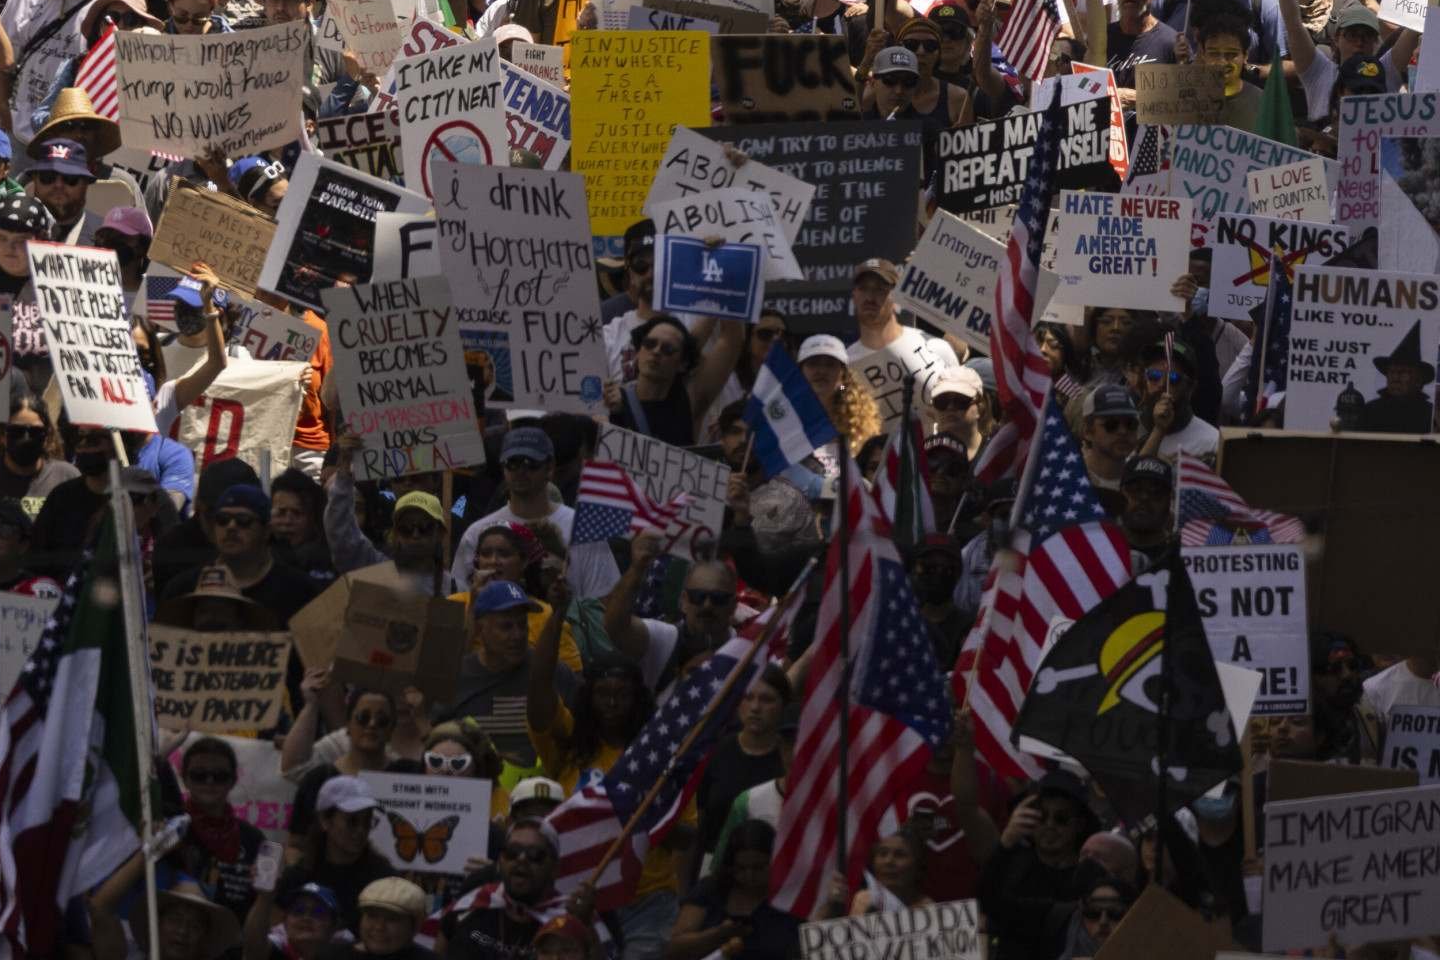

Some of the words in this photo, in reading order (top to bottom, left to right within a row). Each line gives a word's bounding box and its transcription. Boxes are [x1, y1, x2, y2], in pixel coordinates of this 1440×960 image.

[1065, 194, 1114, 216] HATE
[1121, 199, 1181, 220] NEVER
[1097, 218, 1144, 238] MADE
[1075, 235, 1157, 258] AMERICA
[355, 284, 422, 314] WHEN
[1298, 274, 1438, 310] HUMANS
[338, 305, 452, 347] CRUELTY
[1294, 309, 1335, 324] LIKE
[1341, 311, 1394, 328] YOU...
[360, 343, 448, 375] BECOMES
[1292, 338, 1318, 351] WE
[1324, 341, 1370, 355] JUST
[1292, 354, 1339, 369] HAVE
[1345, 355, 1357, 369] A
[357, 375, 448, 407] NORMAL
[348, 400, 471, 435] COMPASSION
[383, 427, 438, 449] LOOKS
[361, 444, 466, 480] RADICAL
[1183, 553, 1299, 573] PROTESTING
[1231, 587, 1294, 617] NOT
[1232, 634, 1252, 662] A
[1269, 855, 1353, 892] MAKE
[1321, 890, 1422, 931] GREAT
